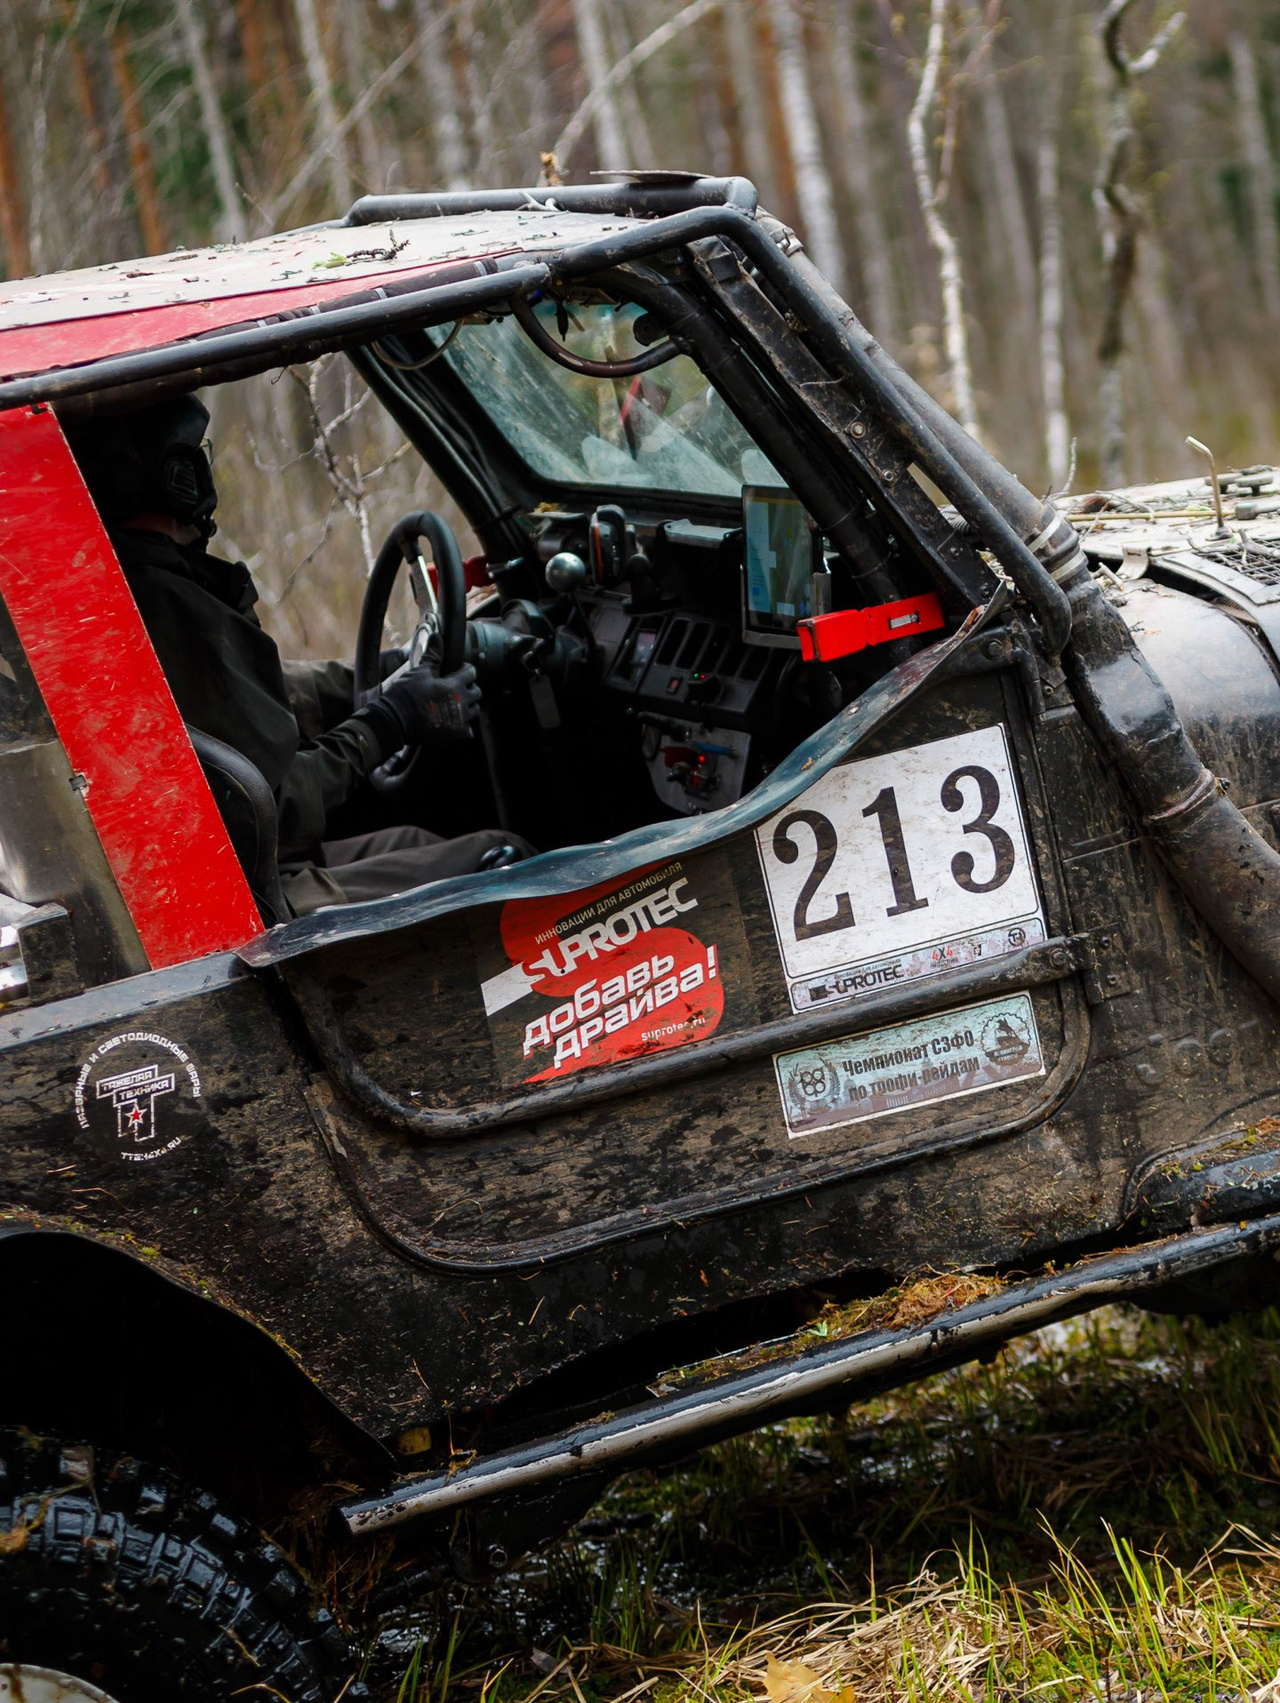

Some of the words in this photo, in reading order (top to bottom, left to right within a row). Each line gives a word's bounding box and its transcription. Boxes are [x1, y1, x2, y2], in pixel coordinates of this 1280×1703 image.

[772, 765, 1015, 942] 213
[535, 907, 596, 945] ИННОВАЦИИ
[596, 896, 618, 914] ДЛЯ
[619, 862, 682, 902] АВТОМОБИЛЯ
[523, 877, 699, 990] SUPROTEC
[89, 1053, 100, 1063] И
[97, 1032, 190, 1063] СВЕТОДИОДНЫЕ
[843, 1045, 929, 1076] Чемпионат
[931, 1029, 975, 1056] СЗФО
[119, 1079, 170, 1101] ТЕХНИКА
[848, 1081, 868, 1103] по
